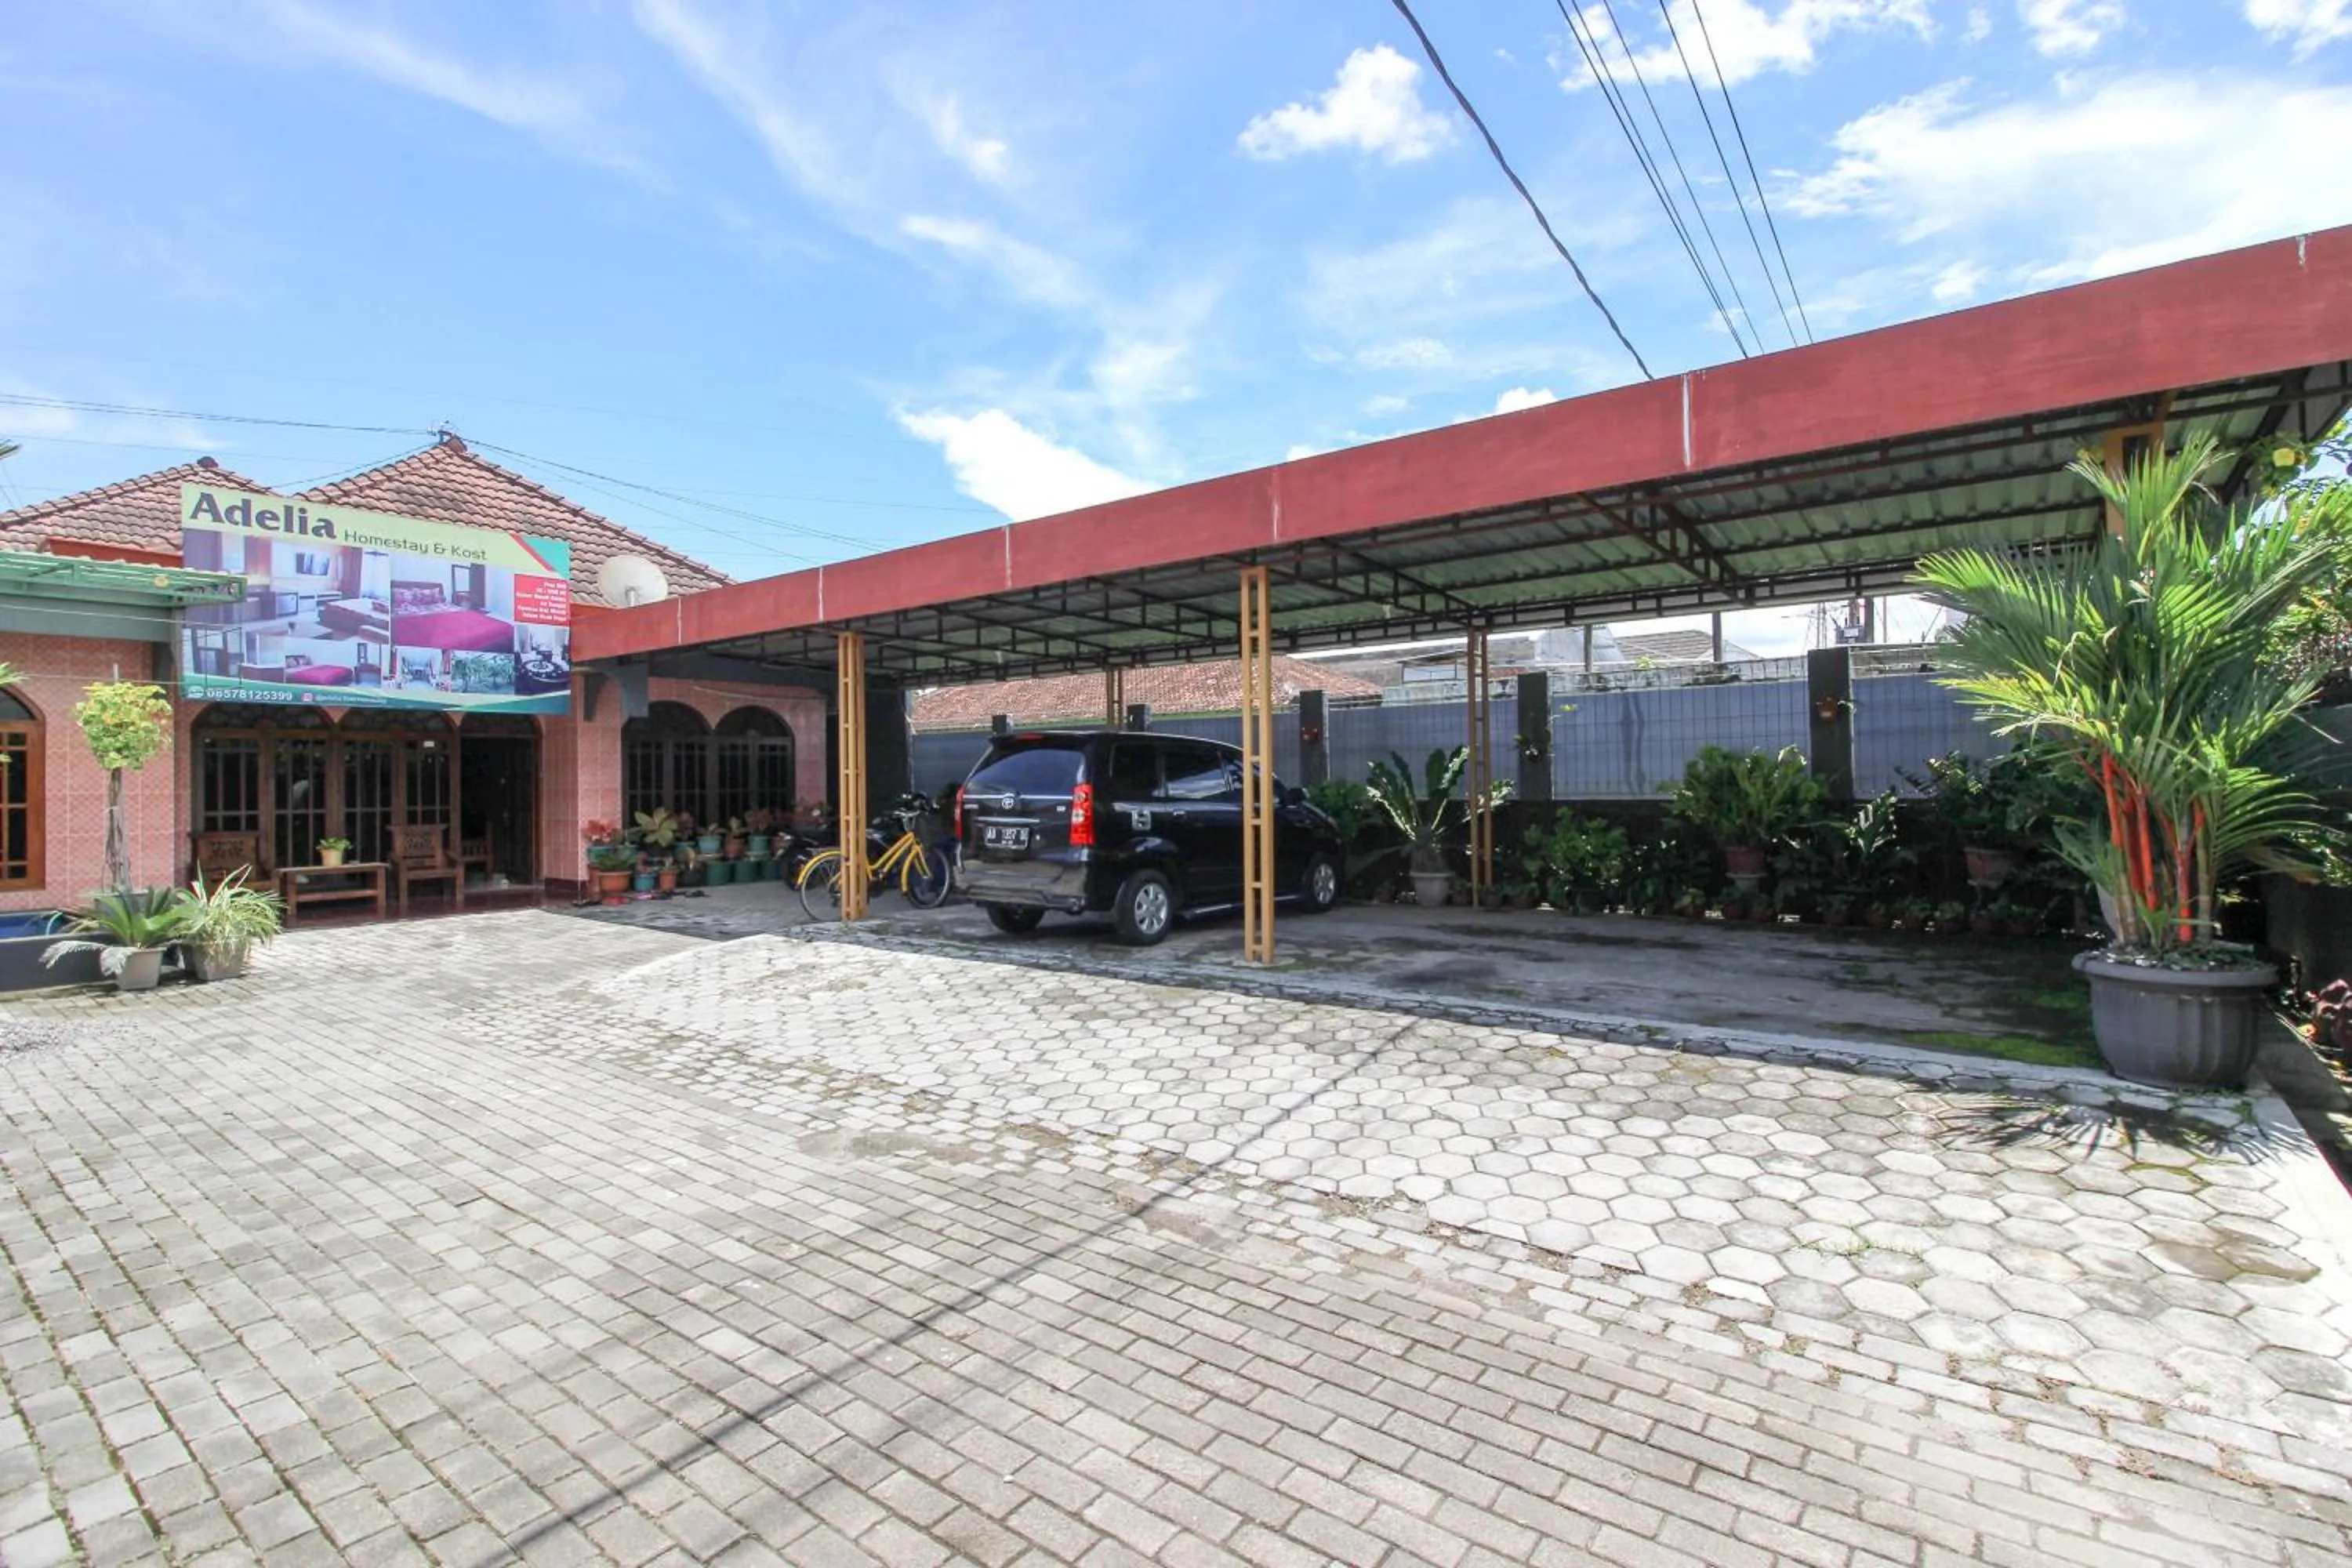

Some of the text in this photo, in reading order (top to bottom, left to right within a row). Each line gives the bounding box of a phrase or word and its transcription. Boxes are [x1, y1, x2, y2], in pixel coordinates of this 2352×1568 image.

[190, 492, 488, 560] Adelia Homestay & Kost
